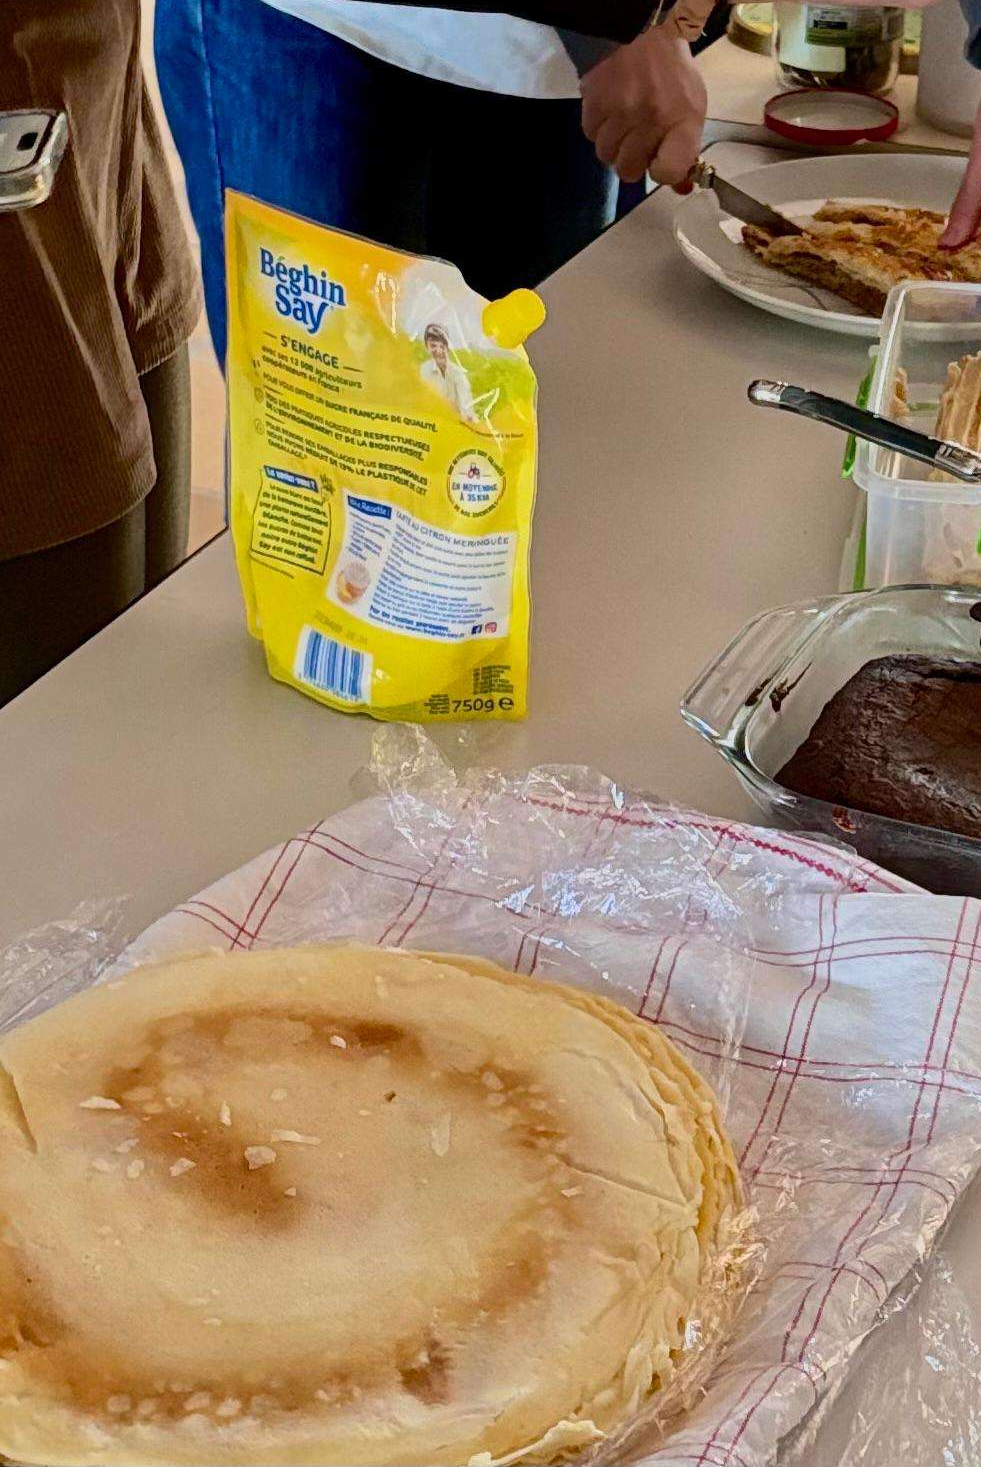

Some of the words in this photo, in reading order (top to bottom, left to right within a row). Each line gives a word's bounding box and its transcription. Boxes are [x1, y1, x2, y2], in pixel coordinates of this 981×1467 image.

[259, 247, 346, 307] Béghin
[275, 283, 329, 334] Say
[280, 334, 340, 369] S'ENGAGE
[349, 407, 389, 421] FRANÇAIS
[390, 415, 401, 424] DE
[345, 436, 355, 445] DE
[357, 439, 367, 447] LA
[363, 430, 430, 452] RESPECTUEUSES
[358, 458, 377, 468] PLUS
[356, 468, 365, 477] LE
[463, 483, 498, 492] MOYENNE
[420, 526, 451, 544] CITRON
[451, 697, 495, 712] 750g
